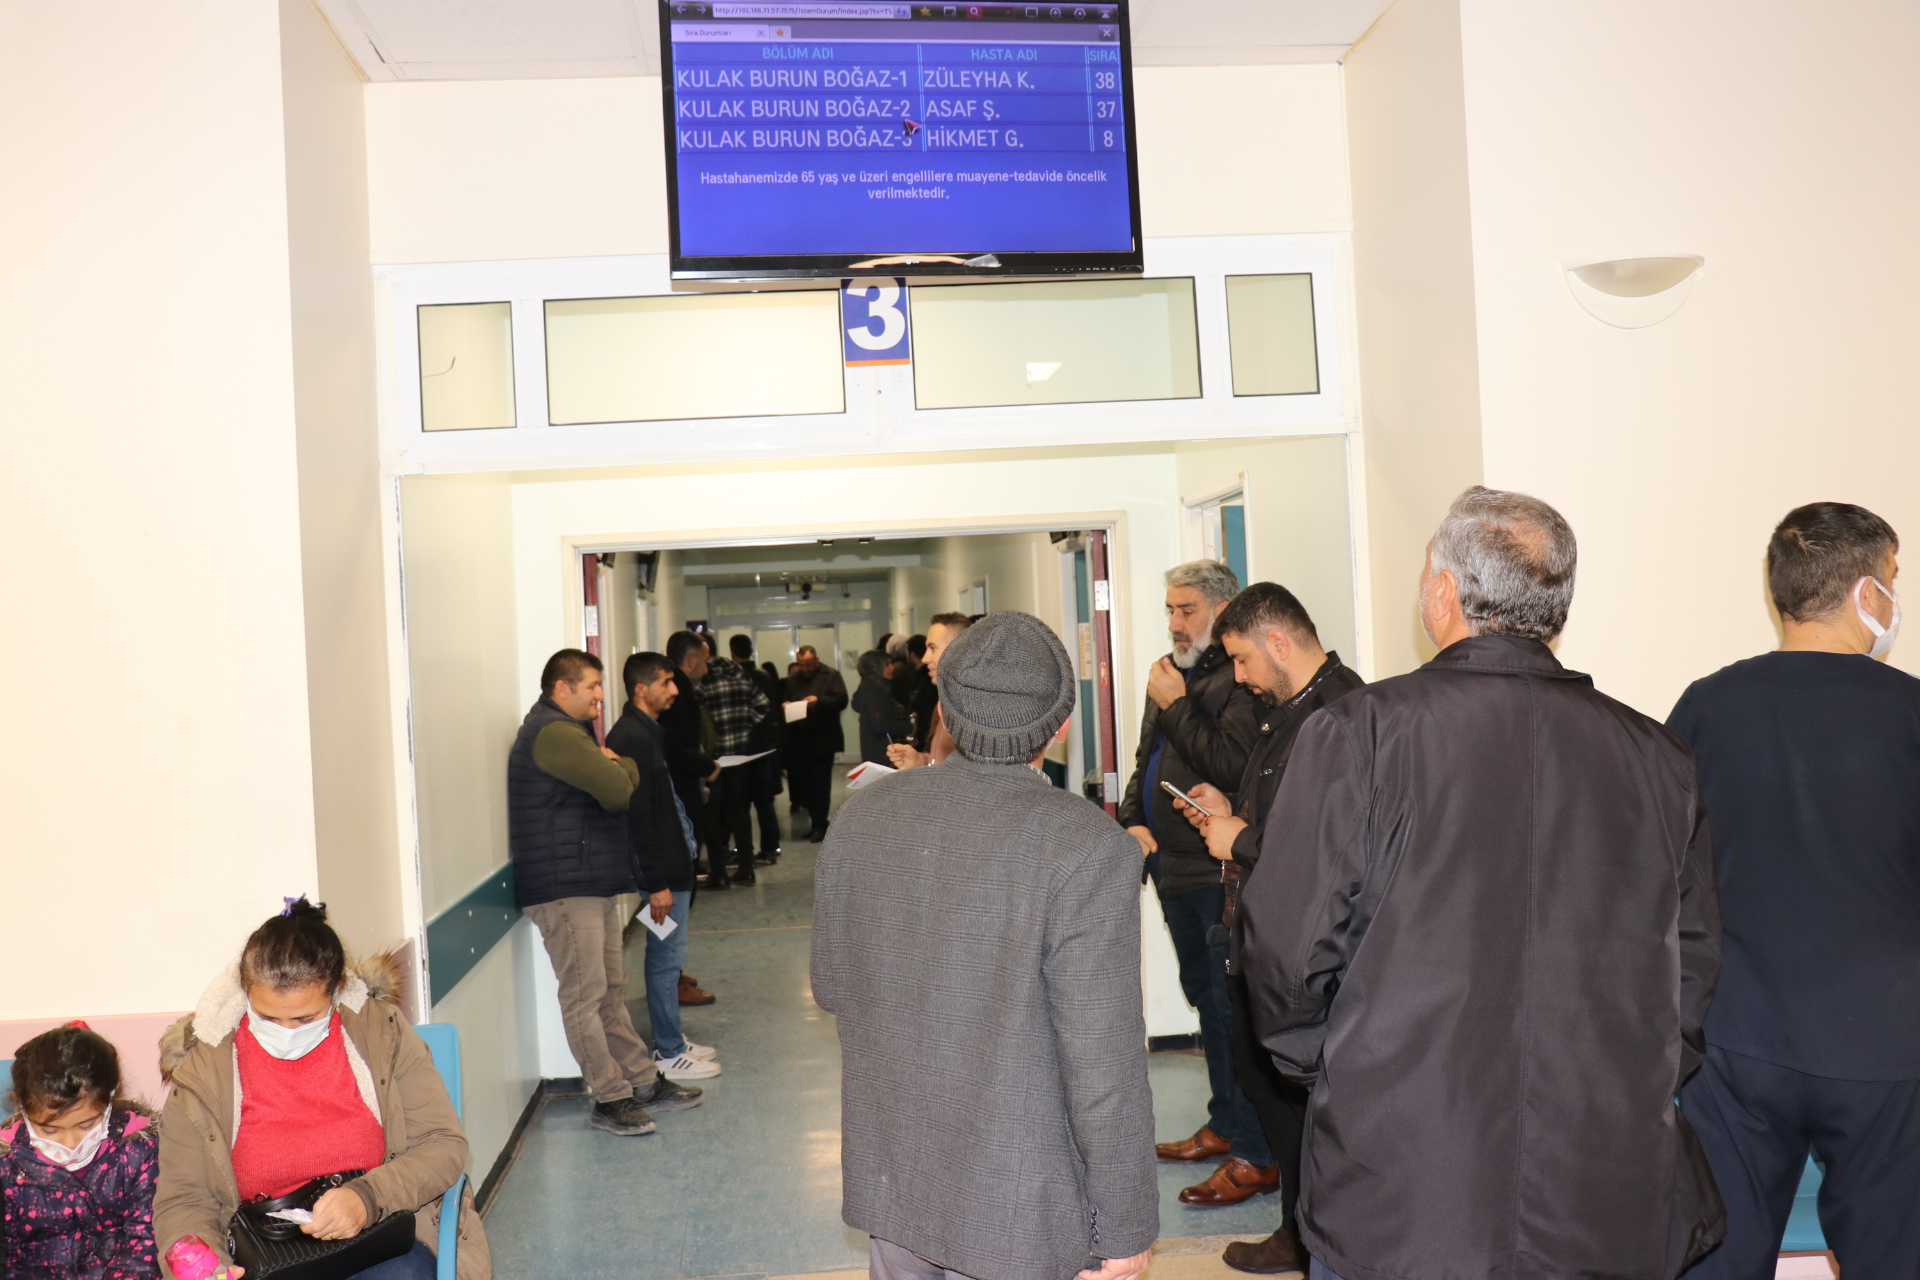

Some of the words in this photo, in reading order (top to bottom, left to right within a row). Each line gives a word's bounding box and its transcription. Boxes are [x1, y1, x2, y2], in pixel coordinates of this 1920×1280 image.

[762, 47, 808, 60] BÖLÜM
[812, 48, 833, 59] ADI
[971, 49, 1013, 60] HASTA
[1017, 49, 1038, 61] ADI
[1089, 50, 1118, 62] SIRA
[678, 70, 744, 87] KULAK
[750, 70, 817, 87] BURUN
[824, 66, 908, 87] BOĞAZ-1
[924, 67, 1012, 87] ZÜLEYHA
[1017, 71, 1035, 89] K.
[1095, 72, 1115, 89] 38
[679, 100, 745, 117] KULAK
[751, 100, 819, 117] BURUN
[825, 96, 911, 117] BOĞAZ-2
[926, 100, 977, 117] ASAF
[983, 100, 1000, 121] Ş.
[1097, 102, 1115, 118] 37
[681, 130, 747, 148] KULAK
[753, 130, 821, 147] BURUN
[927, 126, 999, 147] HİKMET
[1005, 130, 1024, 147] G.
[1104, 131, 1114, 147] 8
[701, 171, 798, 184] Hastahanemizde
[801, 171, 815, 183] 65
[818, 173, 838, 185] yaş
[842, 173, 856, 182] ve
[859, 171, 888, 183] üzeri
[892, 170, 953, 185] engellilere
[957, 170, 1063, 184] muayene-tedavide
[1066, 170, 1107, 182] öncelik
[868, 187, 950, 199] verilmektedir.
[846, 277, 906, 351] 3
